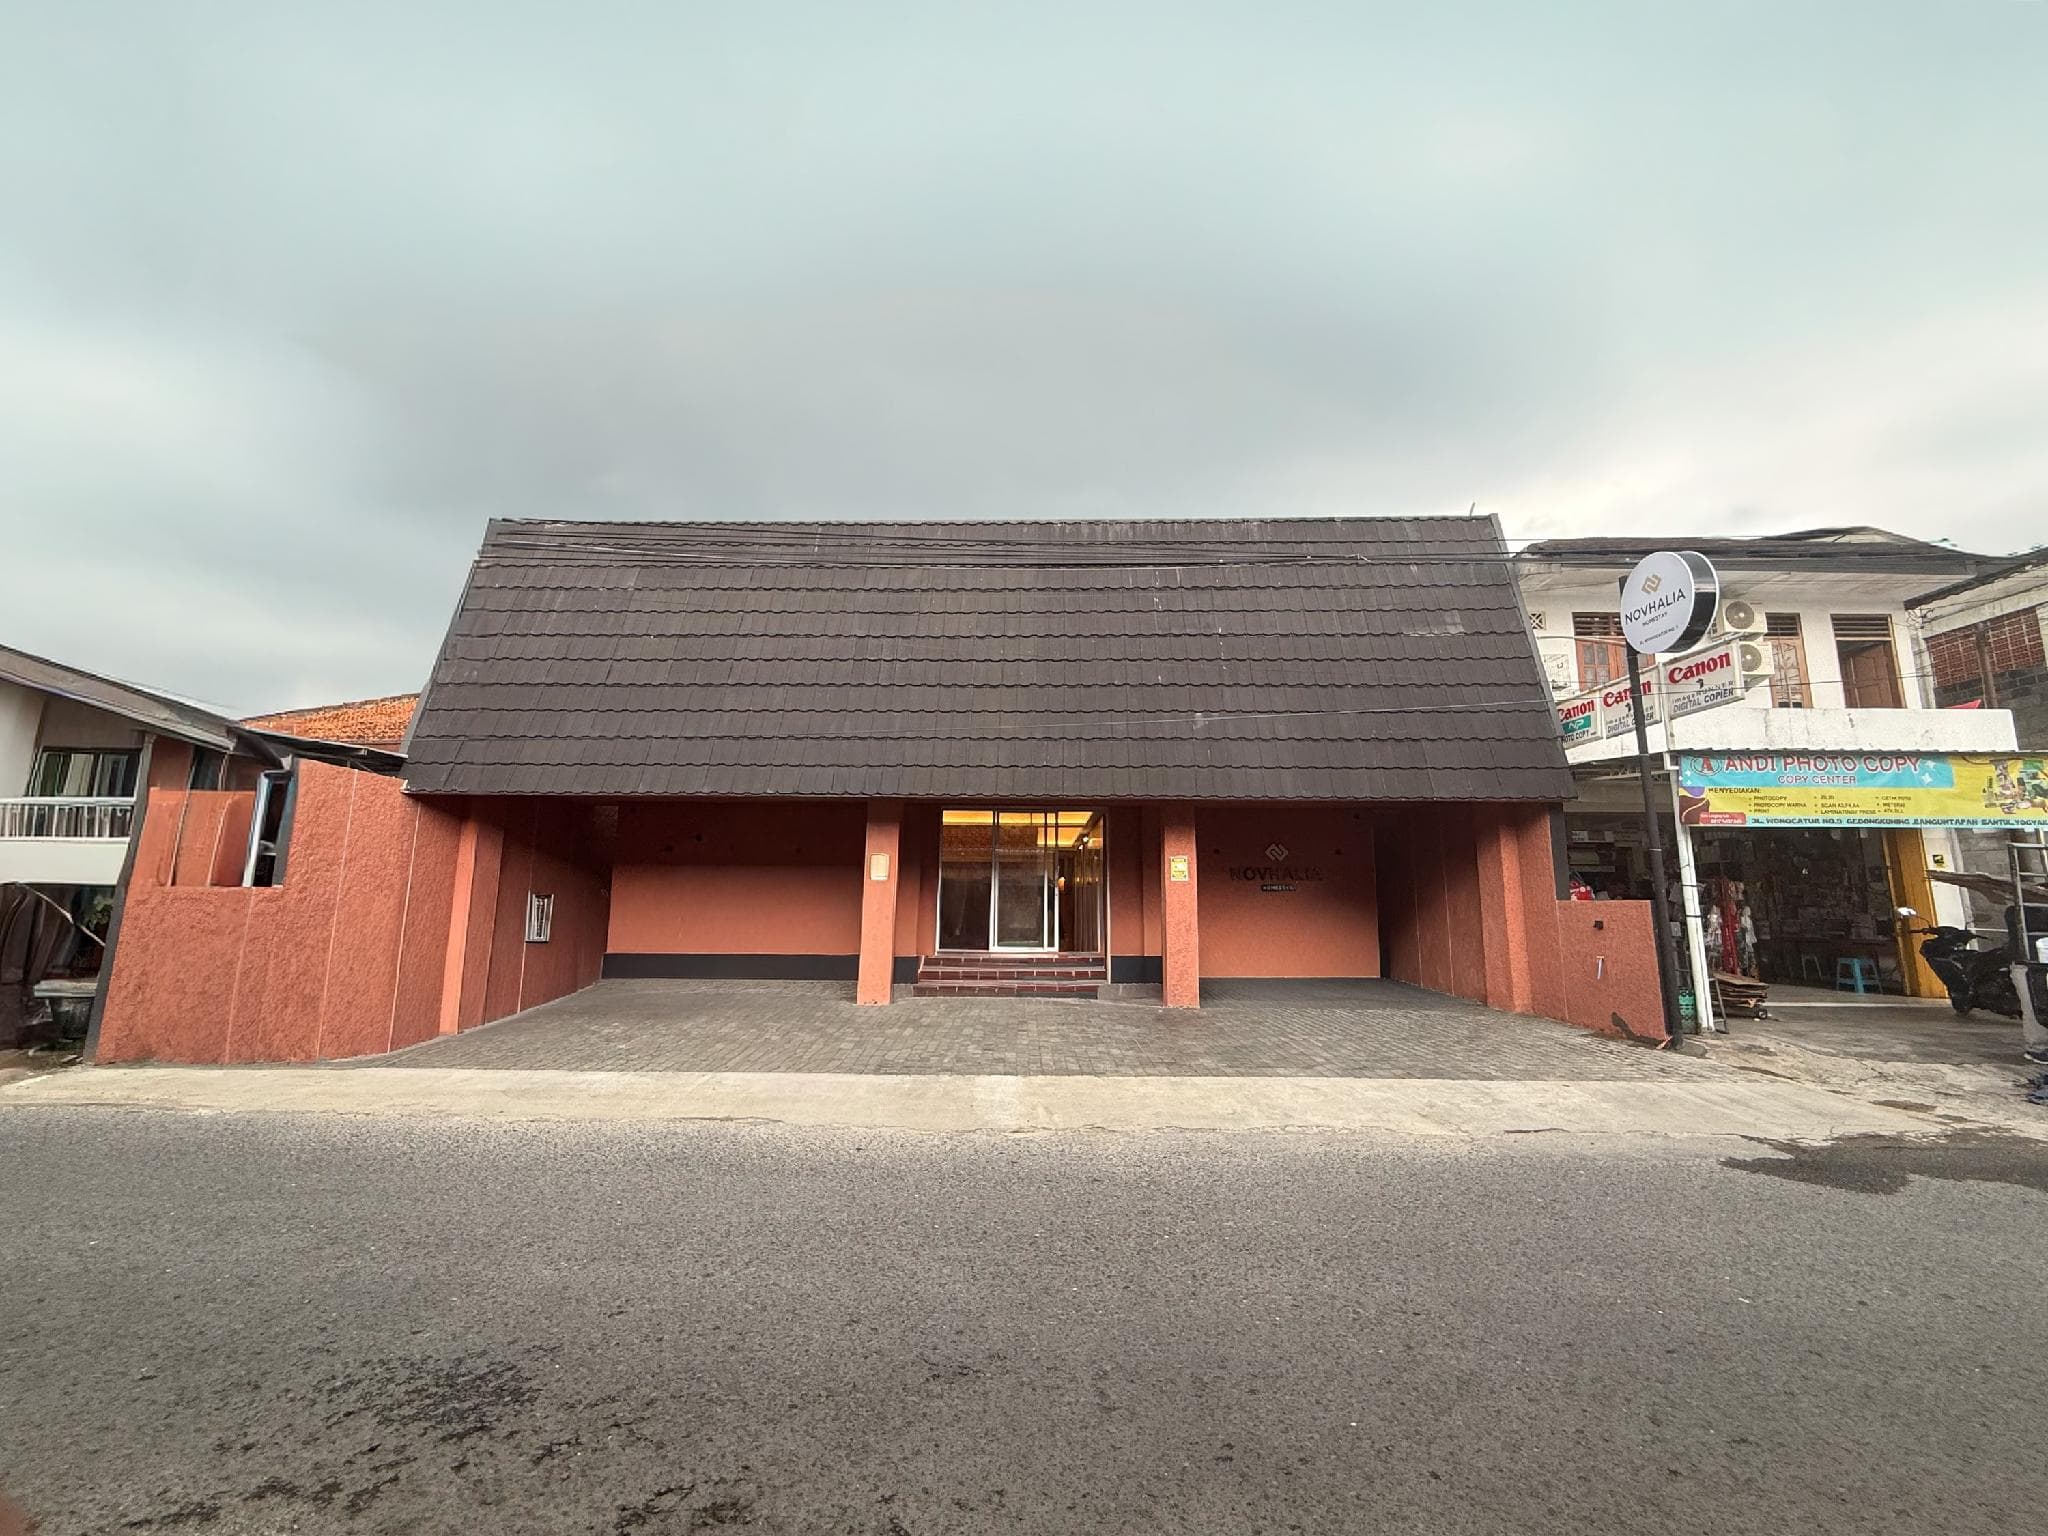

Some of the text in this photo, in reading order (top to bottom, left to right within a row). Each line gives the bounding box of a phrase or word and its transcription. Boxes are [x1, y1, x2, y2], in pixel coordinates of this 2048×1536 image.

[1625, 588, 1686, 625] NOVHALIA
[1668, 652, 1732, 684] Canon
[1603, 680, 1652, 708] Cann
[1673, 688, 1734, 713] DIGITAL COPIER
[1725, 755, 1921, 772] ANDI PHOTO COPY
[1778, 775, 1856, 784] COPY CENTER
